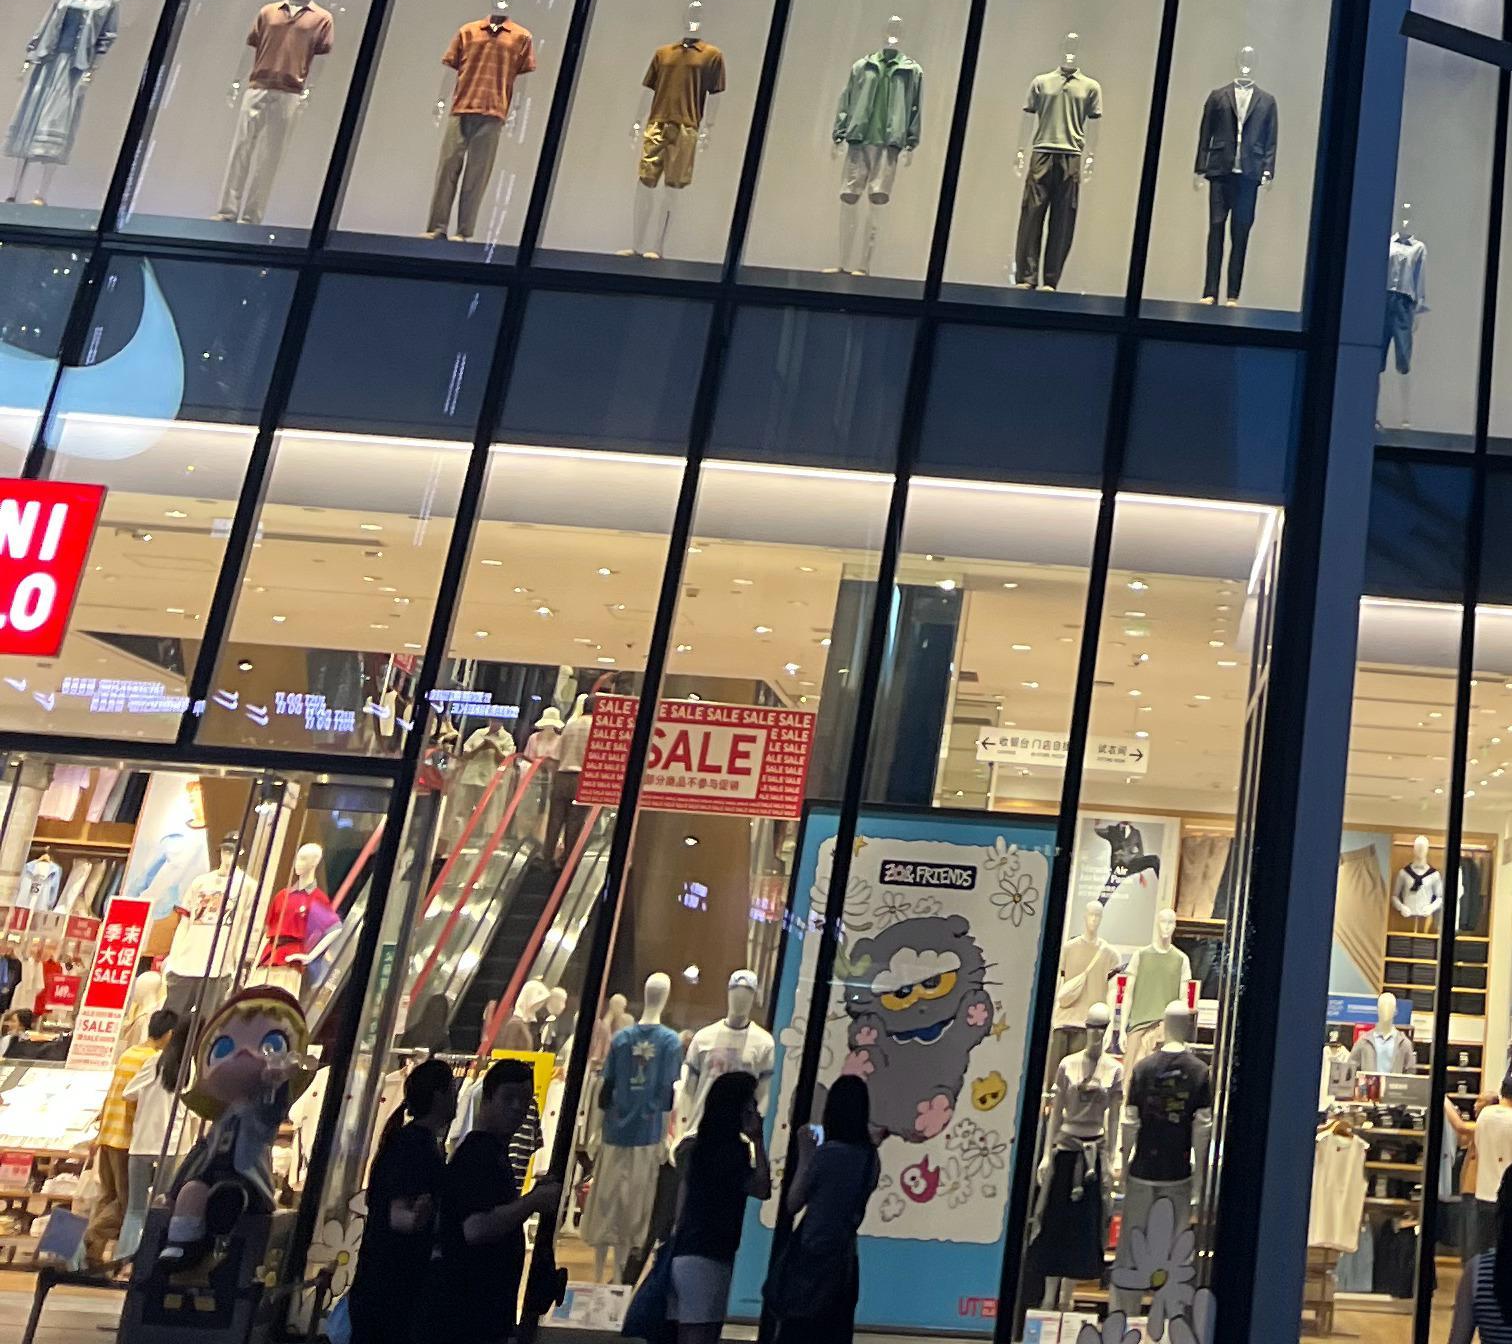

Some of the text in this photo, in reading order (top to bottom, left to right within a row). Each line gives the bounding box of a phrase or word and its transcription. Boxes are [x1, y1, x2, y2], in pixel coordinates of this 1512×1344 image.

[0, 572, 57, 632] O
[598, 699, 632, 714] SALE
[595, 714, 624, 728] SALE
[671, 705, 704, 720] SALE
[707, 708, 739, 723] SALE
[743, 710, 776, 726] SALE
[779, 713, 812, 728] SALE
[593, 728, 617, 740] SALE
[780, 728, 810, 742] SALE
[613, 742, 628, 752] SAL
[646, 726, 757, 776] SALE
[782, 743, 808, 754] SALE
[915, 865, 973, 887] FRIENDS
[104, 923, 142, 944] 季末
[97, 945, 136, 966] 大促
[92, 967, 131, 985] SALE
[82, 1019, 115, 1033] SALE
